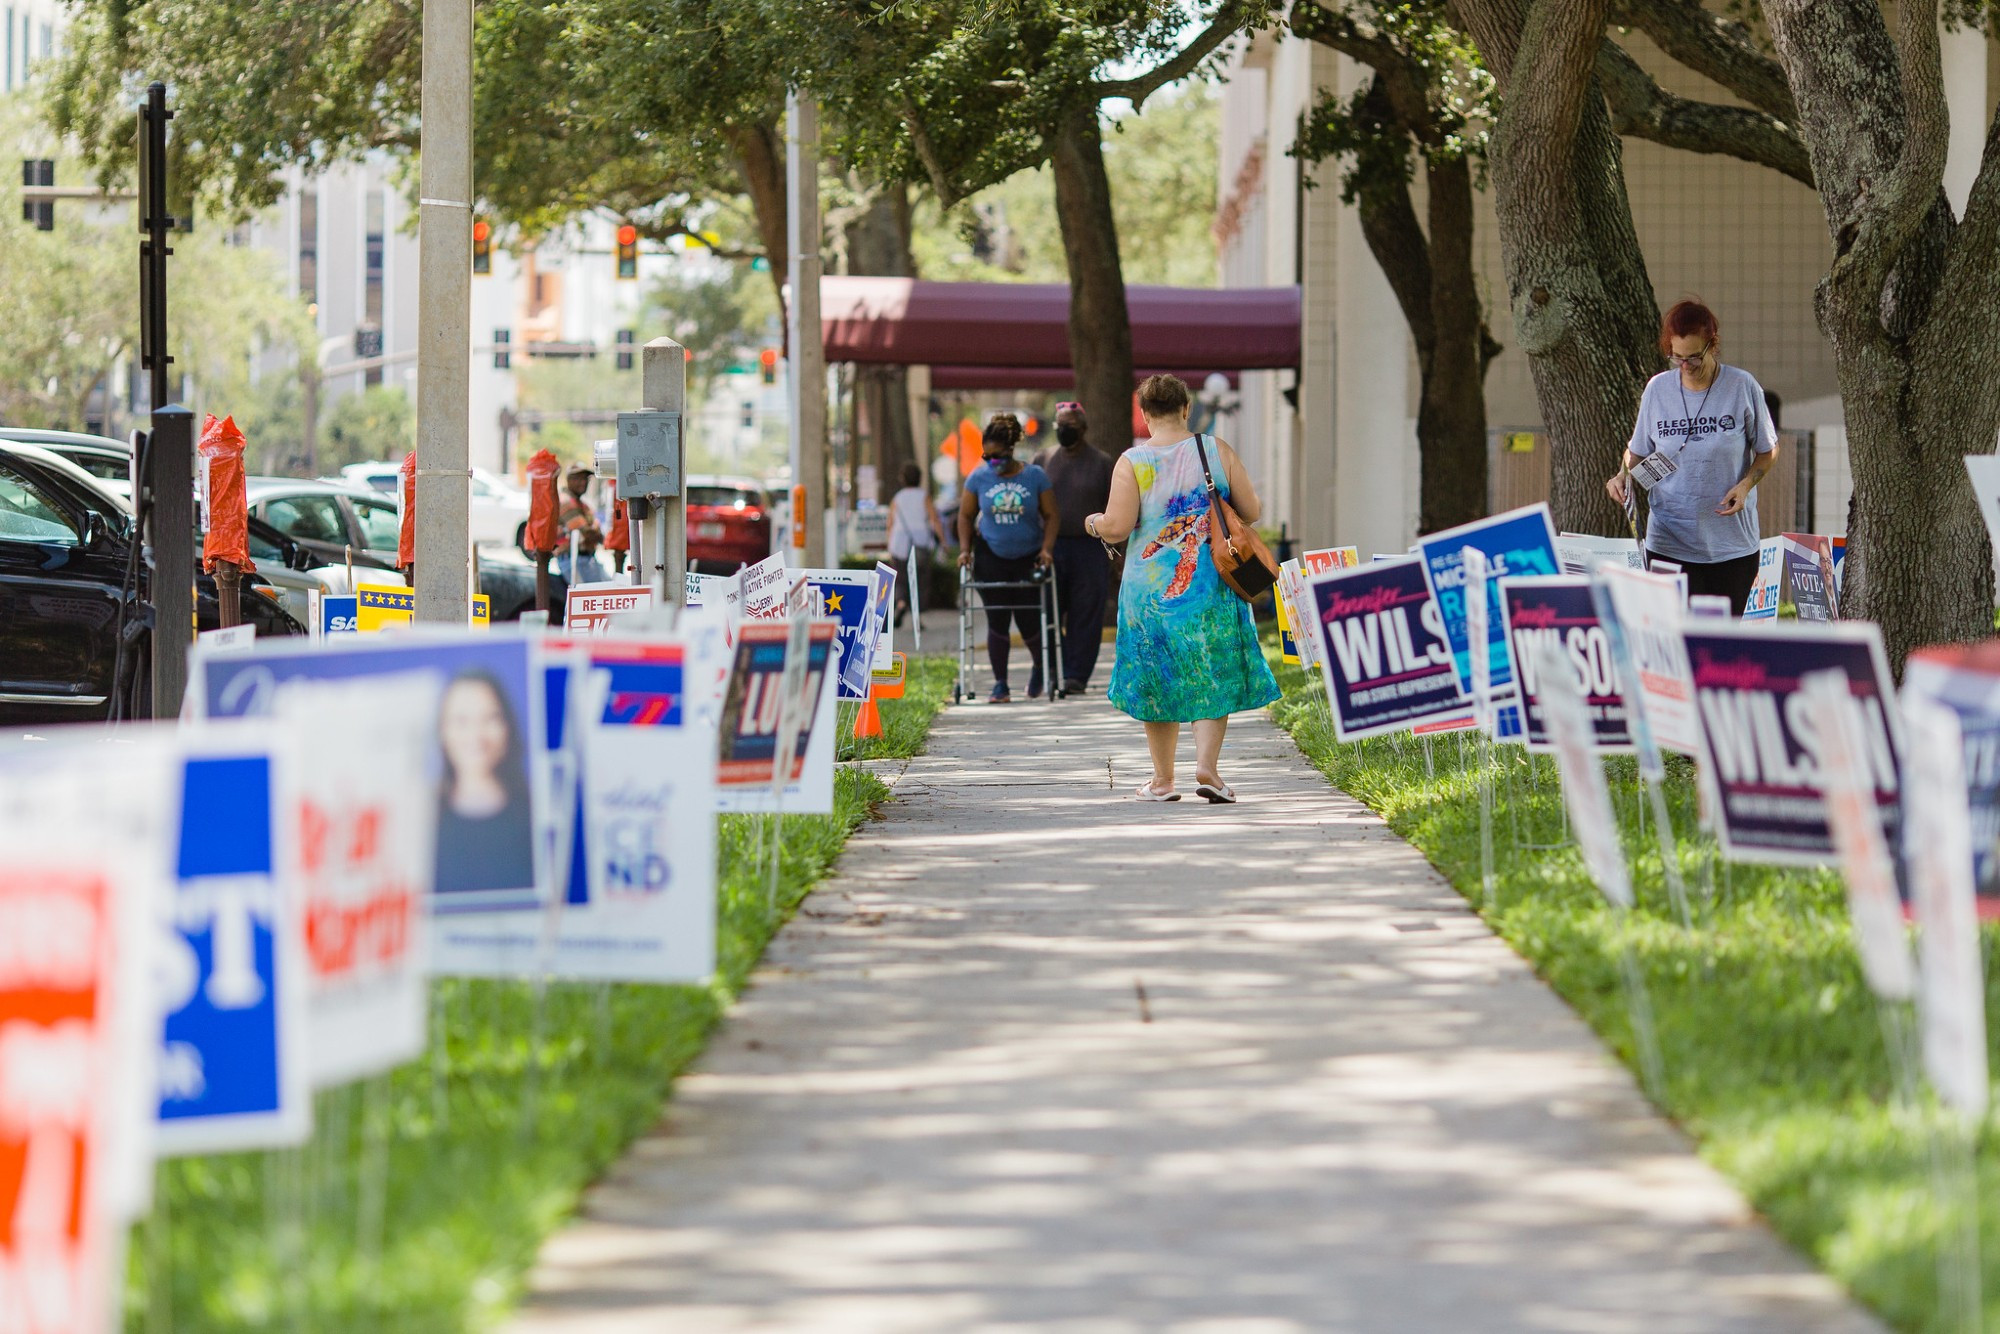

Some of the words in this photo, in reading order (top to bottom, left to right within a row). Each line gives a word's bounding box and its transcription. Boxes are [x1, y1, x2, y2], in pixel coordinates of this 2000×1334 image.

[1657, 416, 1717, 430] ELECTION
[1658, 425, 1717, 438] PROTECTION
[994, 513, 1019, 524] ONLY
[763, 568, 785, 587] FIGHTER
[1794, 573, 1821, 593] VOTE
[582, 597, 637, 612] RE-ELECT
[1322, 586, 1402, 623] Jennifer
[1327, 600, 1449, 684] WILS
